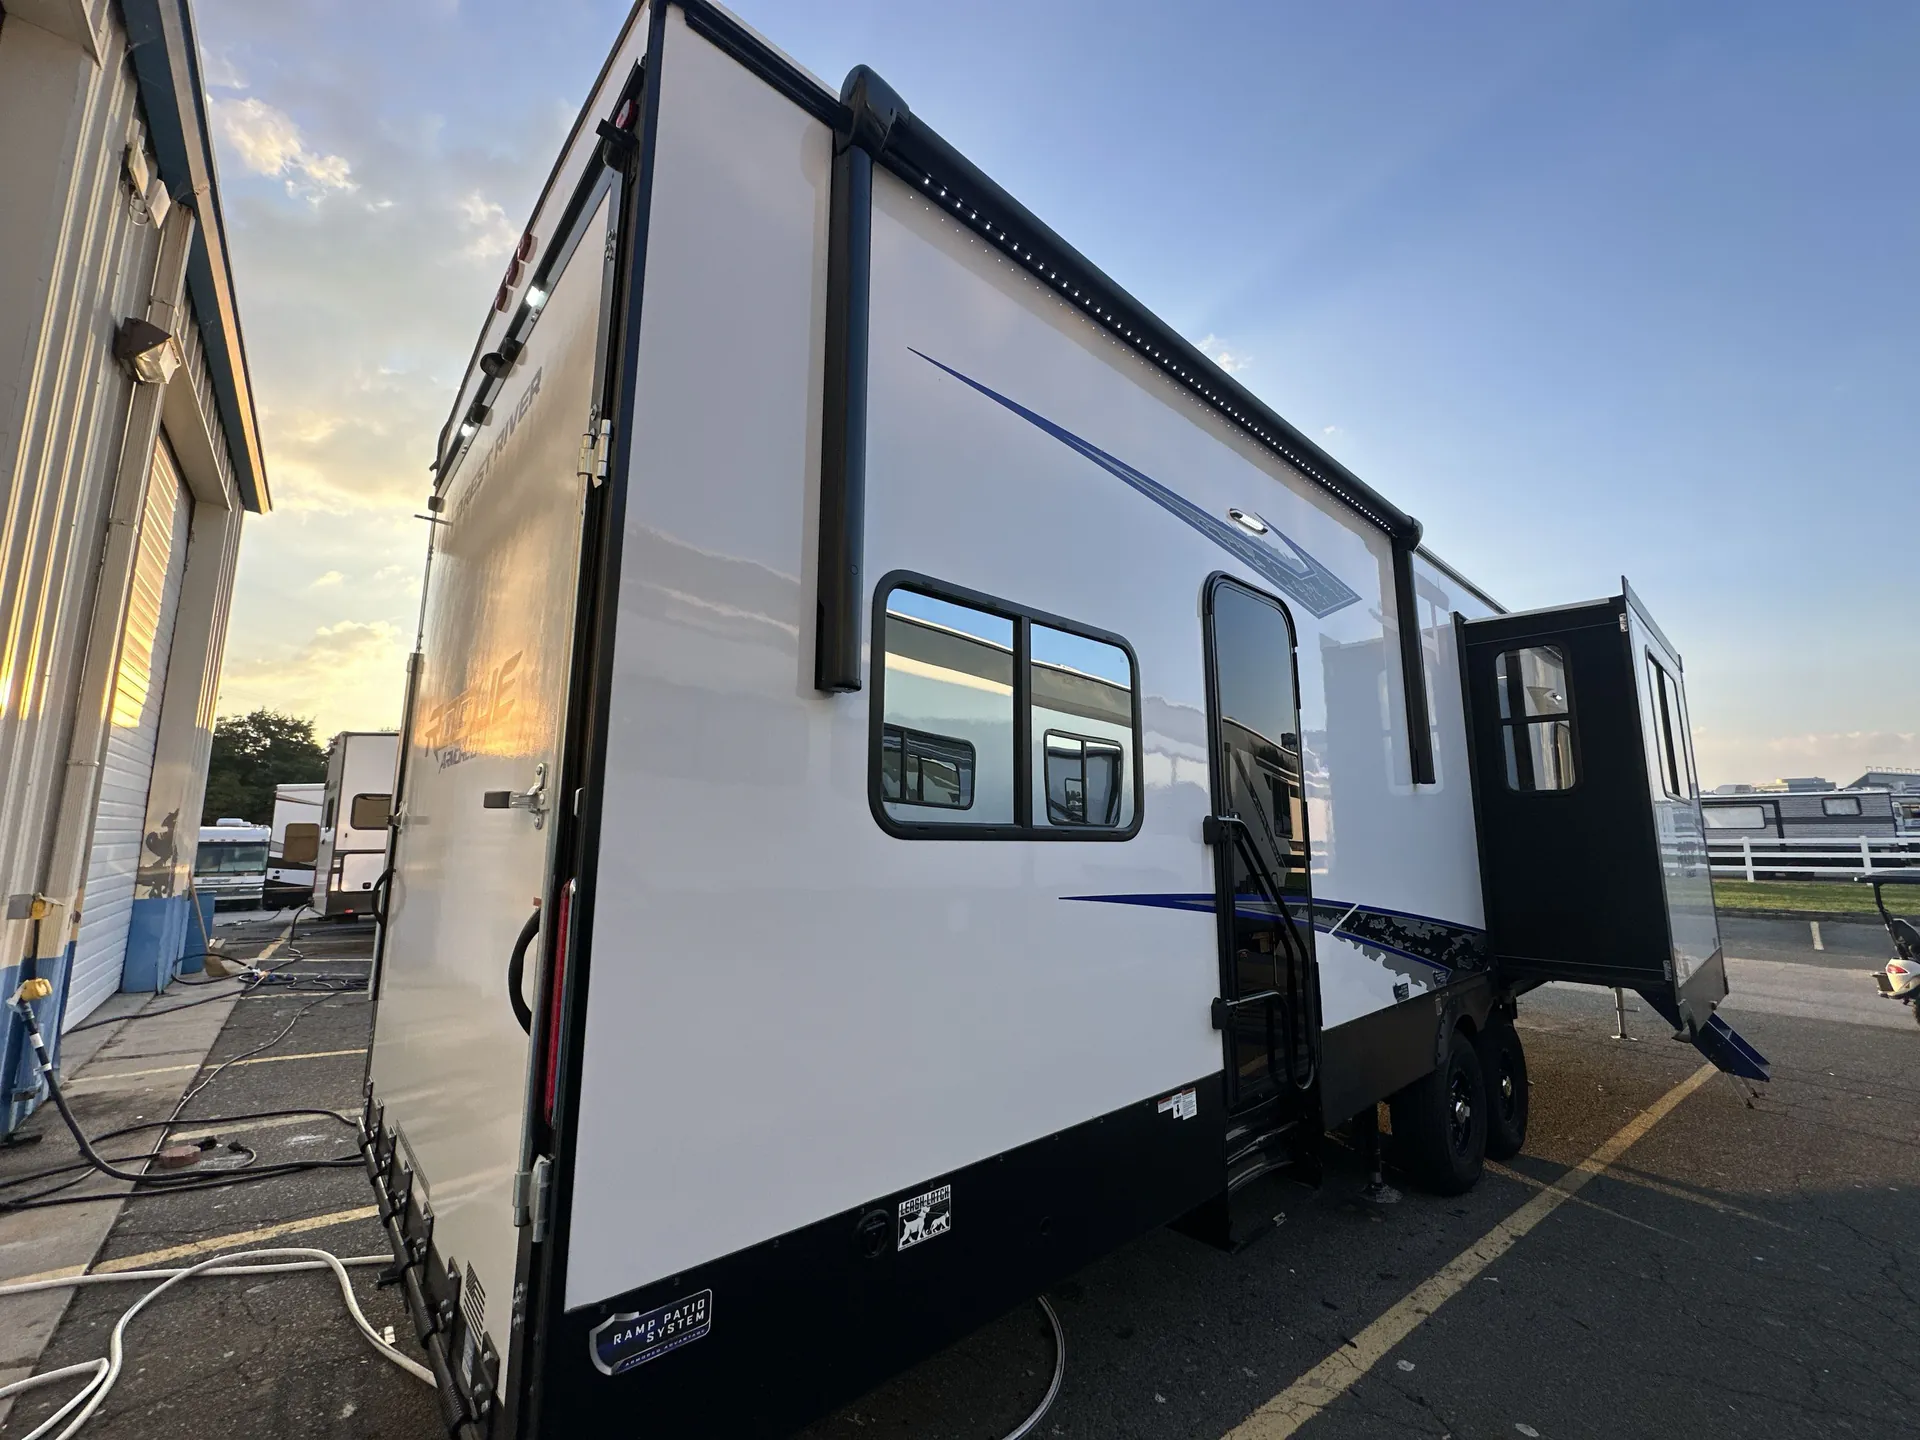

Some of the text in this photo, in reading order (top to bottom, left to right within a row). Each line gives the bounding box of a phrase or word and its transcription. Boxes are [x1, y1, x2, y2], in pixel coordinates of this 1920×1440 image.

[494, 366, 543, 462] RIVER
[613, 1298, 705, 1346] RAMP PATIO
[646, 1310, 705, 1343] SYSTEM
